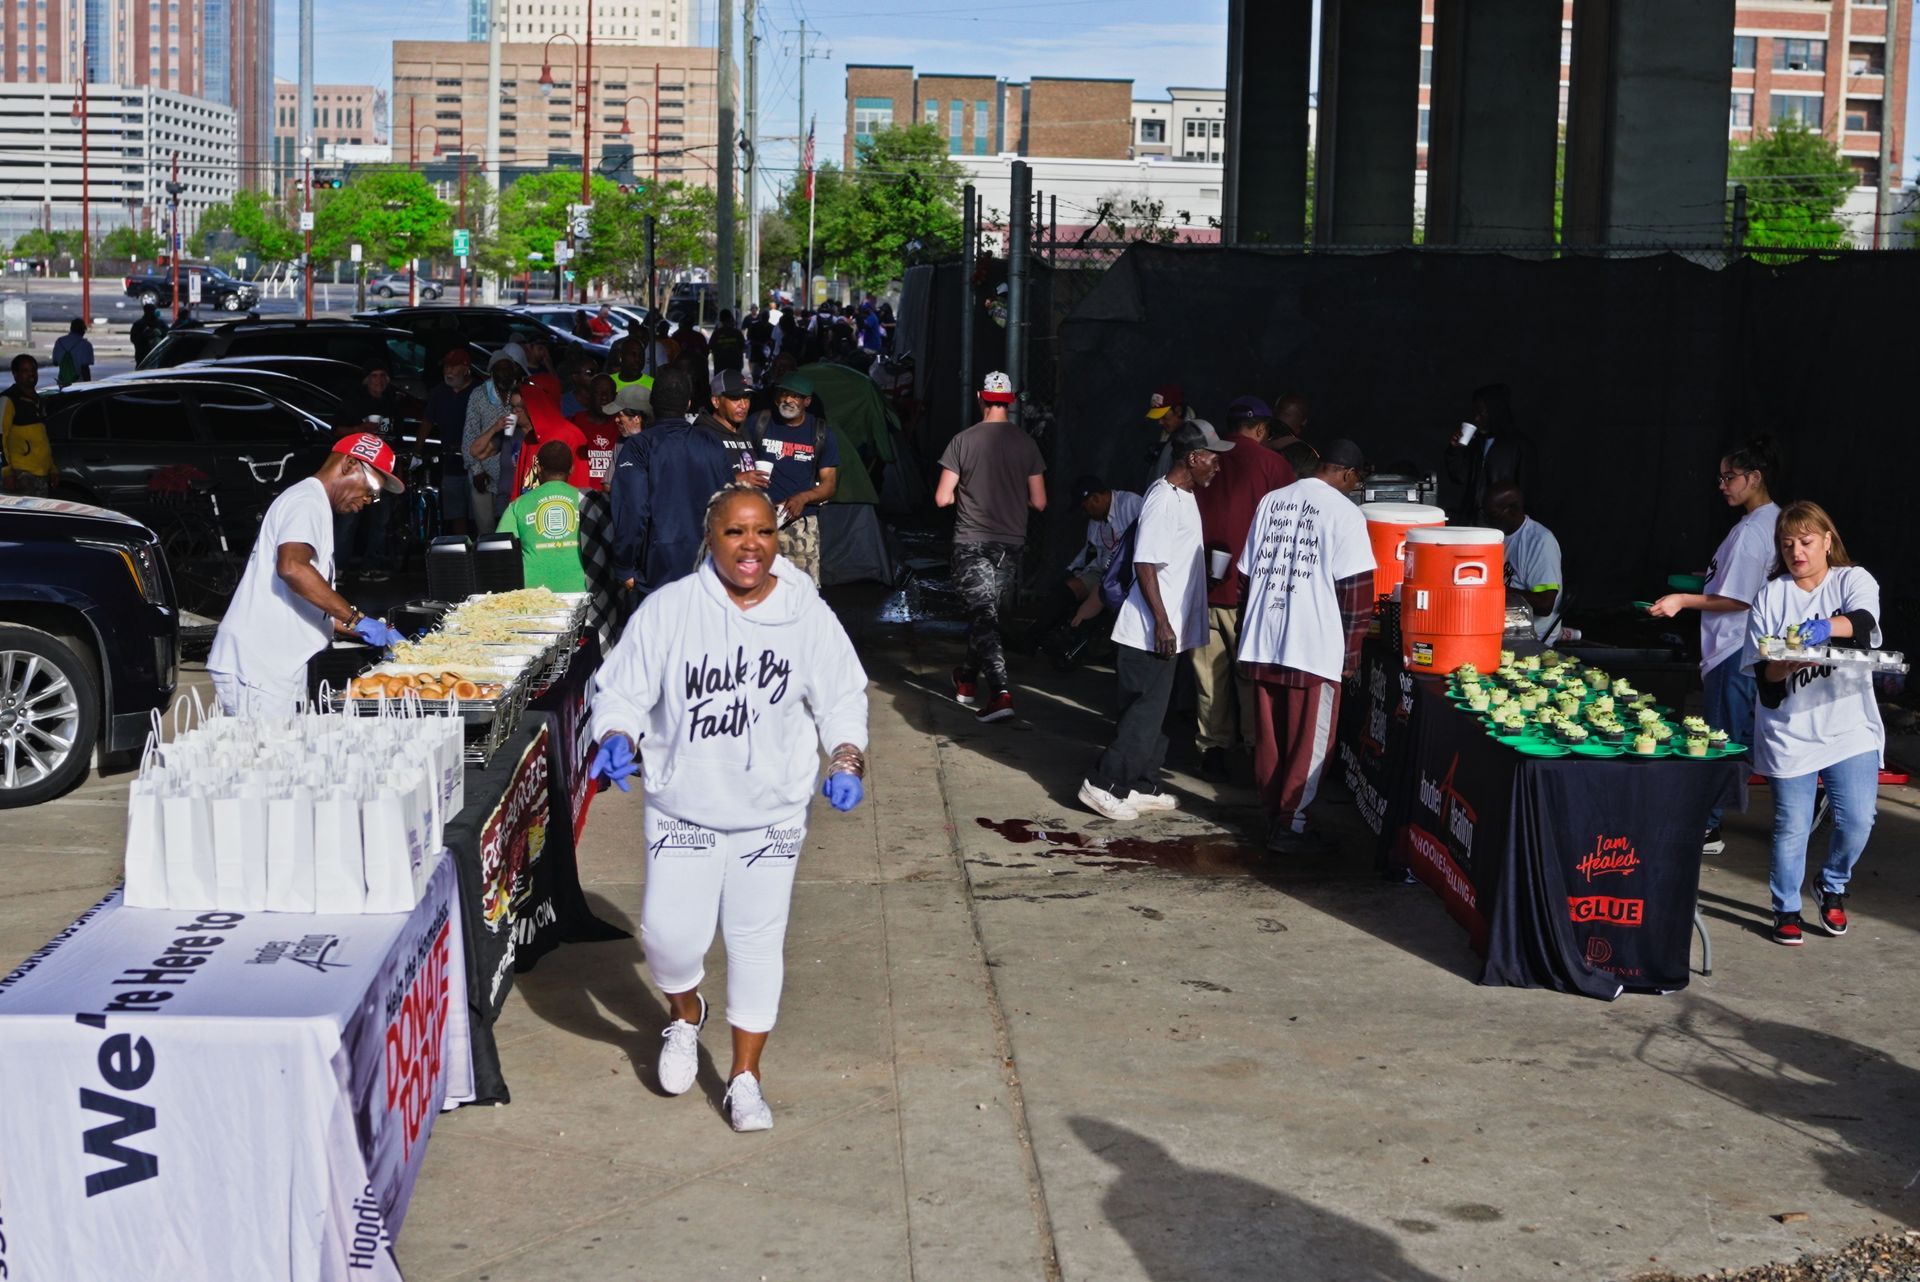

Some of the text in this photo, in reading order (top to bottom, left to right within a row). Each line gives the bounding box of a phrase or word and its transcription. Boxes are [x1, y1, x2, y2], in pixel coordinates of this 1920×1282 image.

[1270, 499, 1320, 518] When You
[1269, 516, 1314, 531] begin with
[1299, 536, 1319, 549] and
[1297, 550, 1319, 566] Faith
[686, 645, 793, 704] Walk By
[688, 698, 760, 743] Faith
[671, 830, 716, 848] Healing
[1603, 835, 1630, 850] am
[385, 918, 450, 1113] DONATE
[75, 912, 245, 1198] We're Here to
[401, 995, 450, 1164] TODAY
